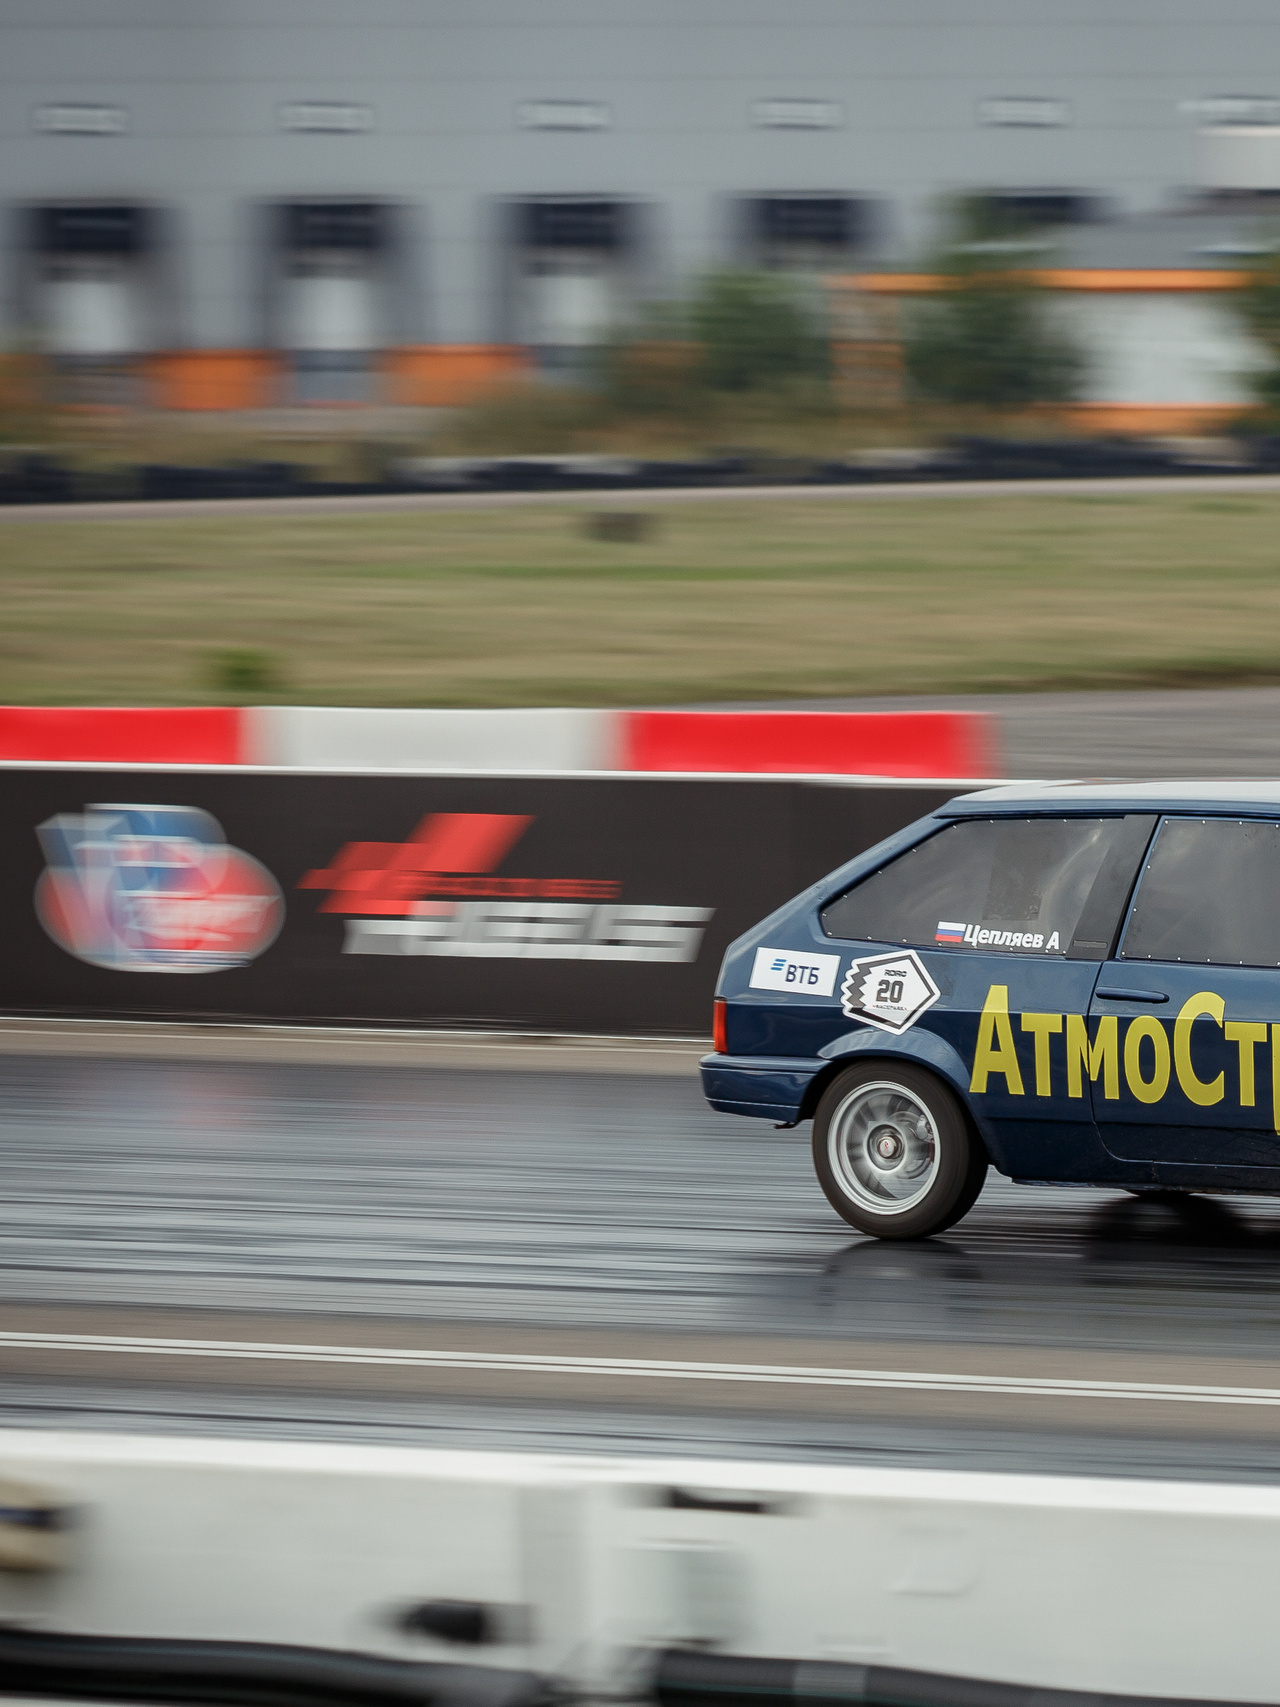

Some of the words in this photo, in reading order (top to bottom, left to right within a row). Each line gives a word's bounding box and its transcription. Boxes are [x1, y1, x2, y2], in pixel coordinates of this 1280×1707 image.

[964, 924, 1044, 949] Цепляев
[1045, 930, 1060, 950] А
[785, 964, 821, 985] ВТБ
[876, 979, 904, 1003] 20
